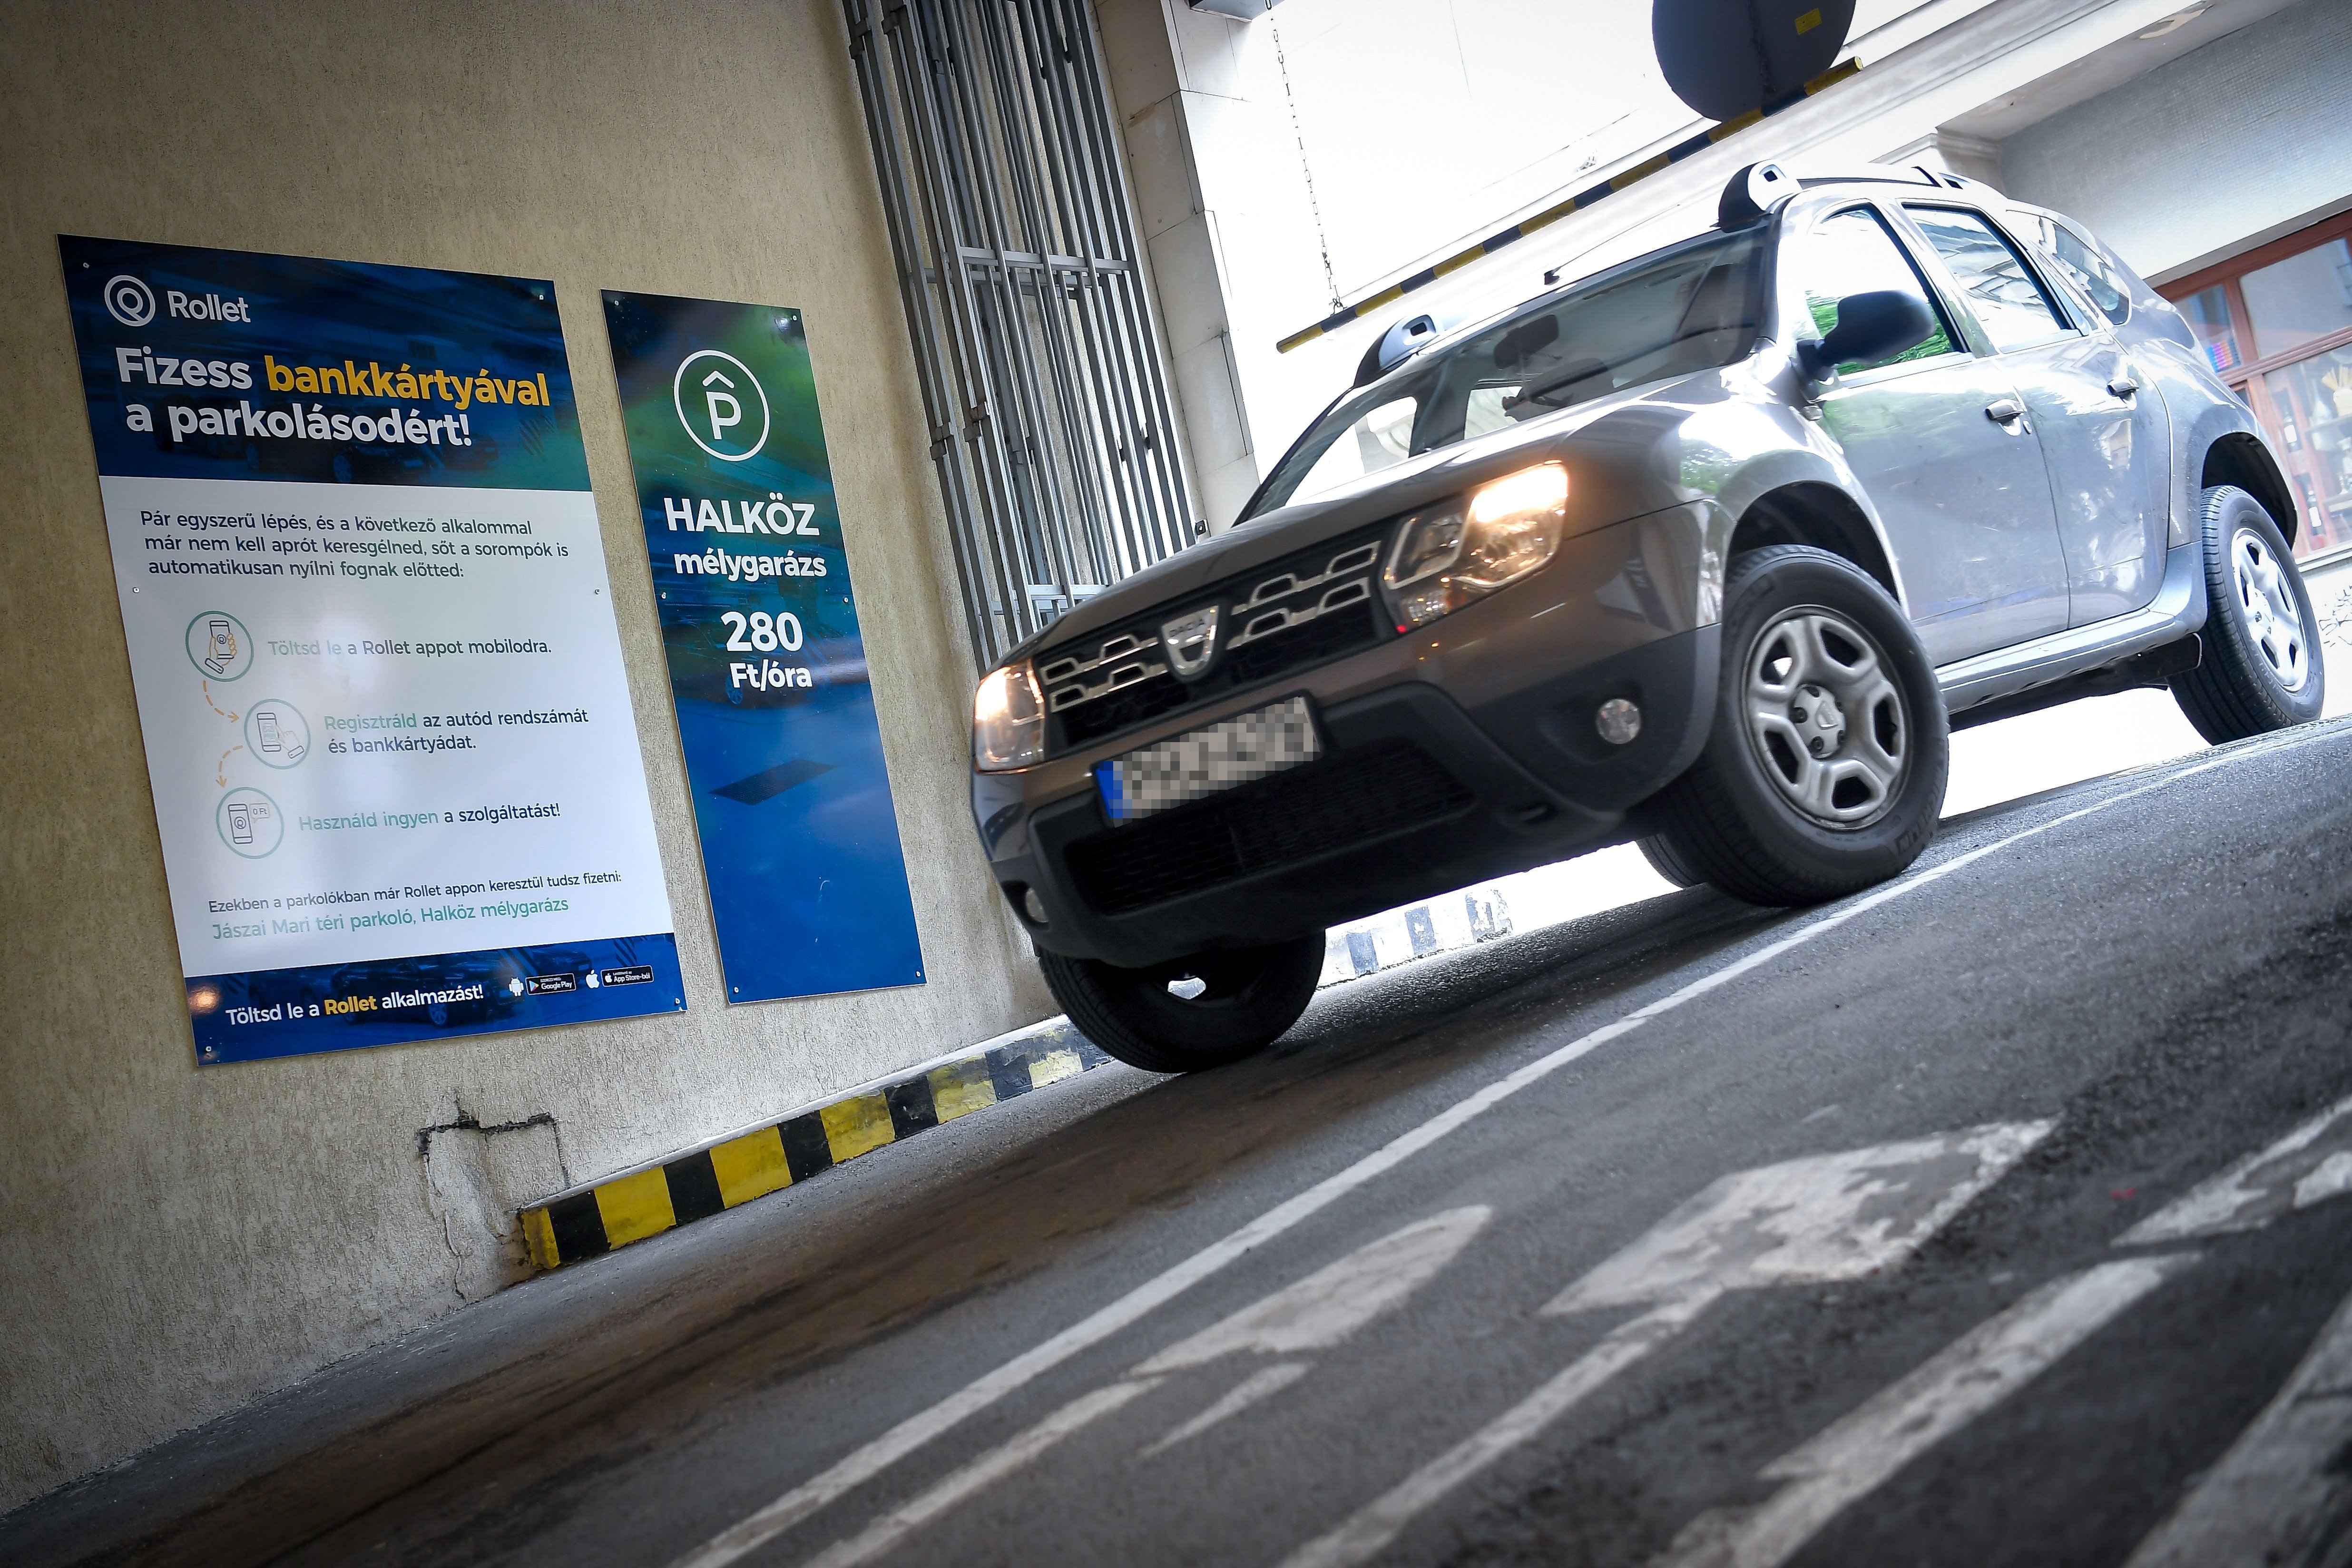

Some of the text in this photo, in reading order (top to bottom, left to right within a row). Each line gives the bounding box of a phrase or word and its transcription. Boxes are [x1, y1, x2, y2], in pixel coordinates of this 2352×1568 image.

[167, 290, 251, 323] Rollet
[116, 346, 550, 411] Fizess bankkártyával
[126, 400, 472, 447] a parkolásodért!
[140, 510, 532, 535] Pár egyszerű lépés, és a következő alkalommal
[664, 492, 820, 536] HALKÖZ
[145, 534, 568, 559] már nem kell aprót keresgélned, sőt a sorompók is
[148, 559, 464, 580] automatikusan nyílni fognak előtted:
[674, 547, 827, 582] mélygarázs
[266, 638, 551, 658] Töltsd le a Rollet appot mobilodra.
[721, 611, 803, 652] 280
[730, 659, 813, 692] Ft/óra
[324, 708, 589, 733] Regisztráld az autód rendszámát
[328, 734, 476, 754] és bankkártyádat.
[299, 803, 560, 831] Használd ingyen a szolgáltatást!
[208, 870, 622, 913] Ezekben a parkolókban már Rollet appon keresztül tudsz fizetni:
[212, 900, 568, 941] Jászai Mari téri parkoló, Halköz mélygarázs
[225, 984, 484, 1025] Töltsd le a Rollet alkalmazást!
